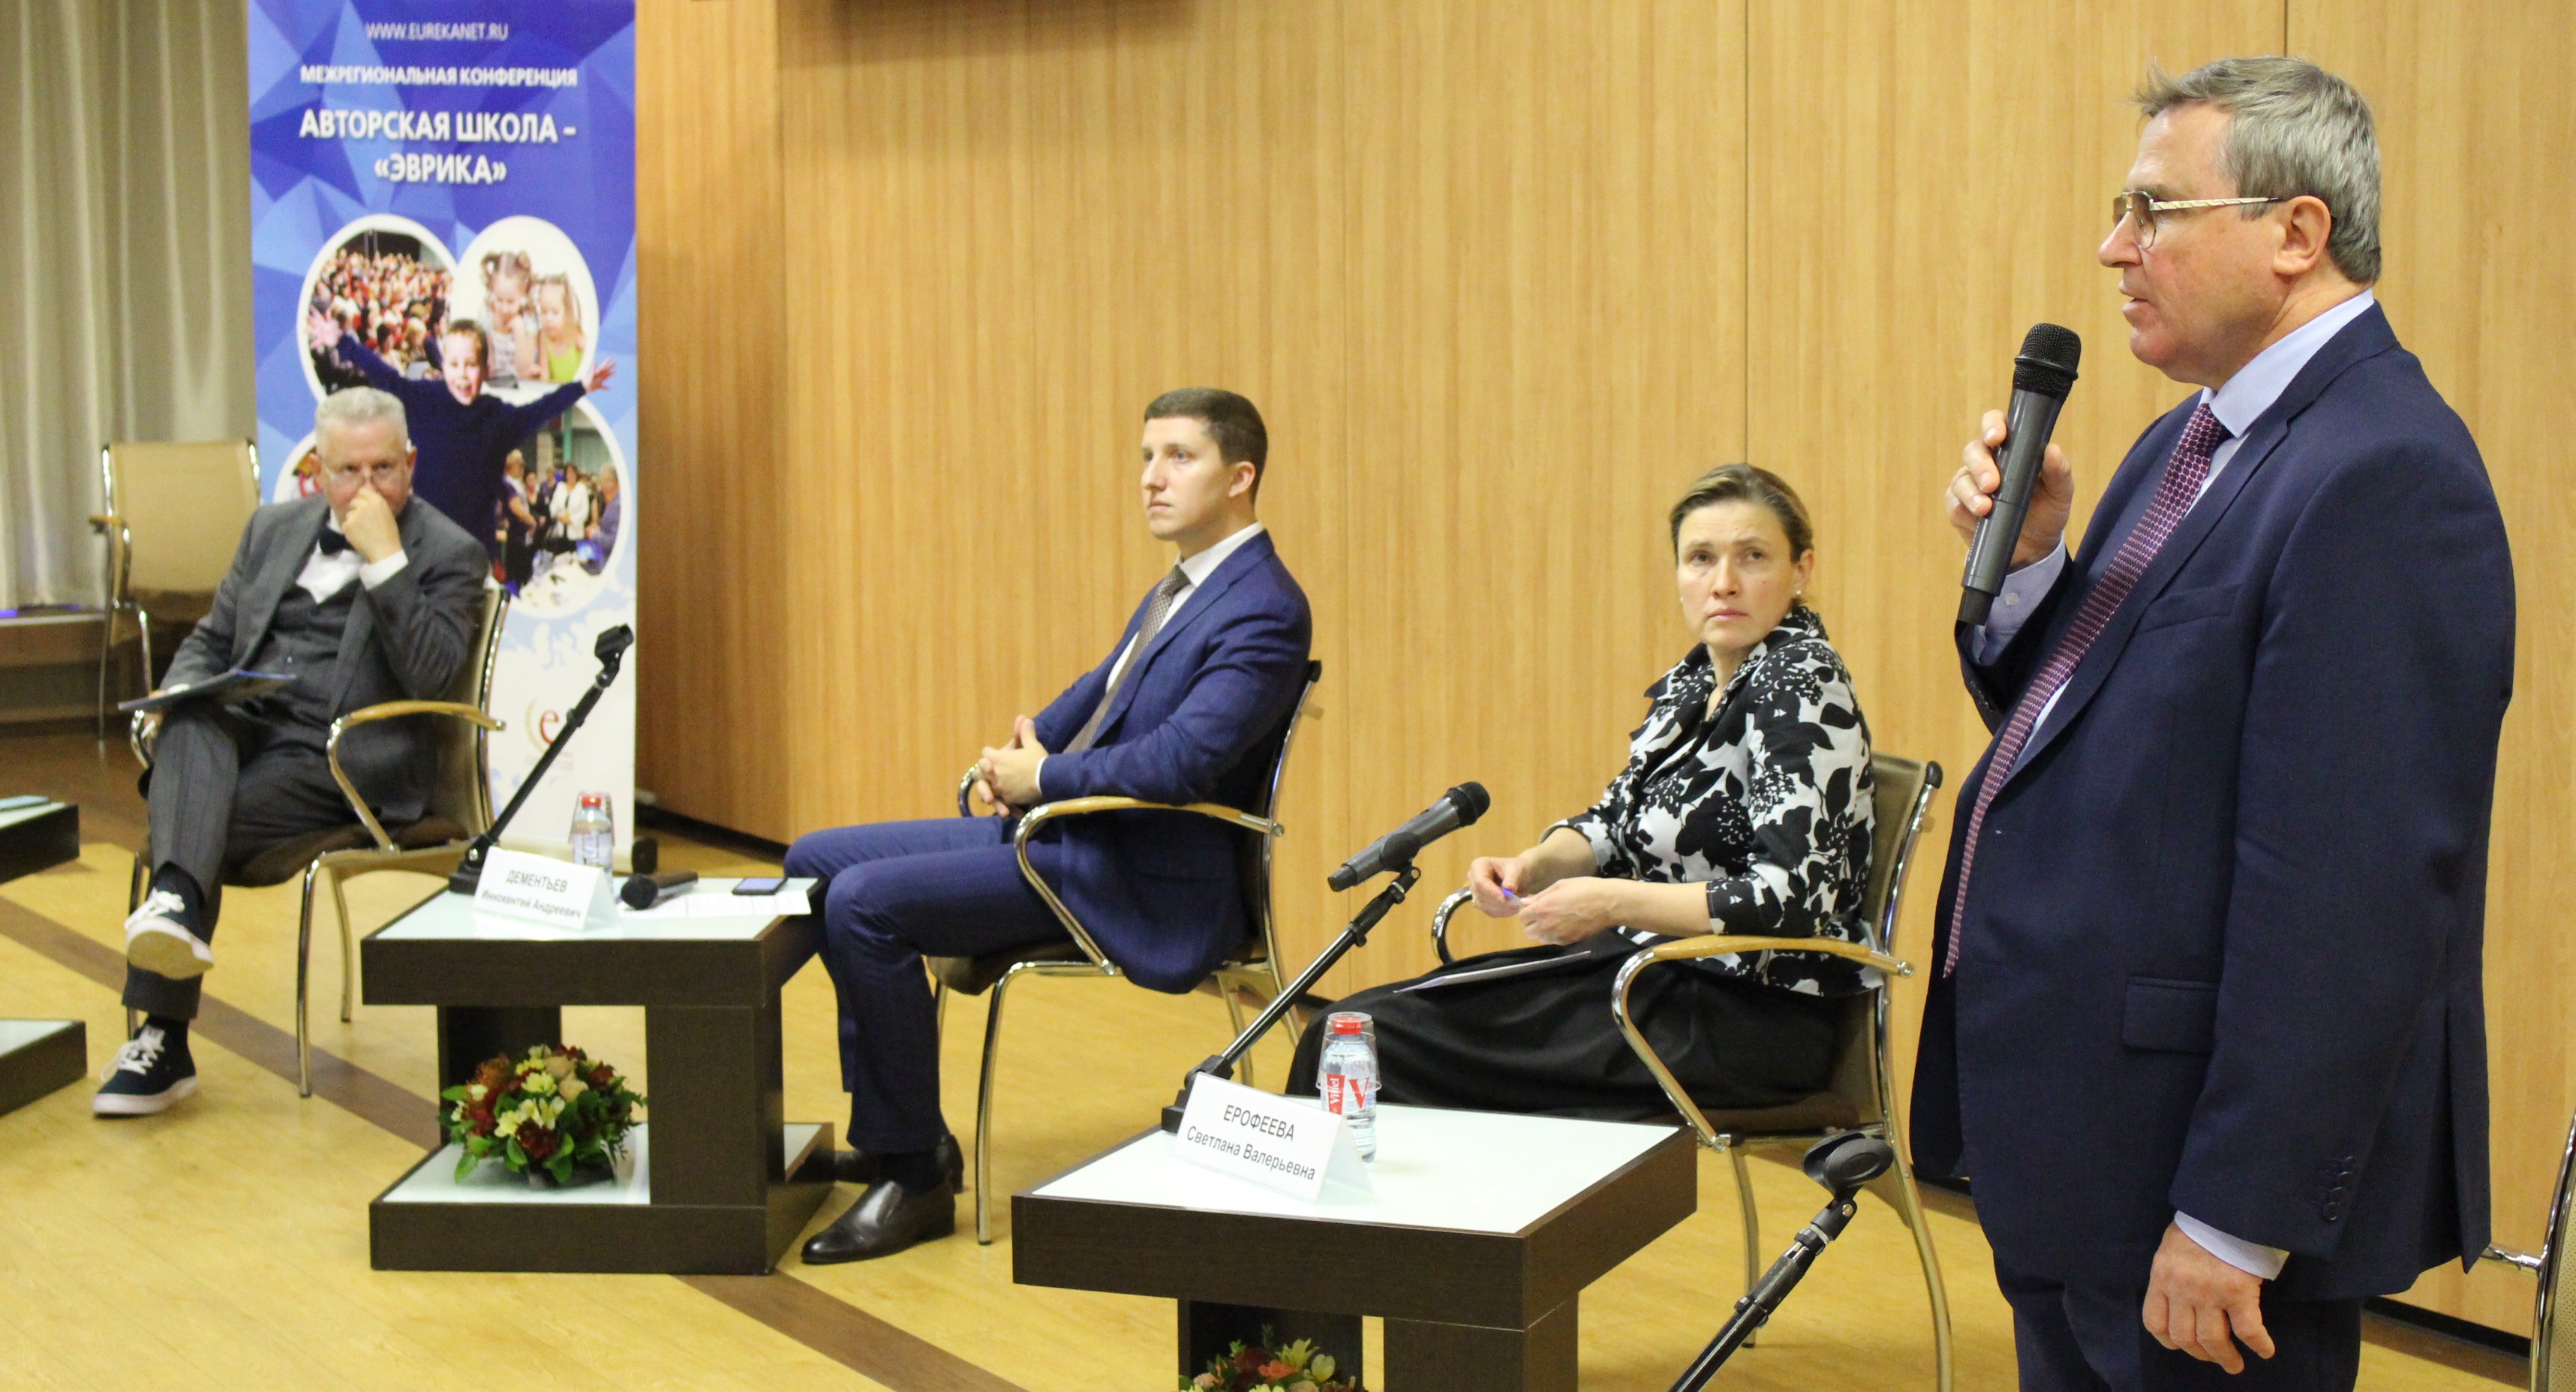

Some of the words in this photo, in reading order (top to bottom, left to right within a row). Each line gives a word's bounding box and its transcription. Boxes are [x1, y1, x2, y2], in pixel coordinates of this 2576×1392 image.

[366, 22, 509, 41] WWW.EUREKANET.RU
[301, 65, 457, 86] МЕЖРЕГИОНАЛЬНАЯ
[459, 67, 578, 89] КОНФЕРЕНЦИЯ
[300, 109, 450, 141] АВТОРСКАЯ
[456, 113, 558, 143] ШКОЛА
[374, 152, 506, 185] «ЭВРИКА»
[506, 869, 568, 893] ДЕМЕНТЬЕВ
[481, 889, 531, 908] Иннокентий
[532, 900, 582, 919] Андреевич
[1223, 1104, 1295, 1141] ЕРОФЕЕВА
[1186, 1125, 1241, 1156] Светлана
[1243, 1143, 1315, 1180] Валерьевна
